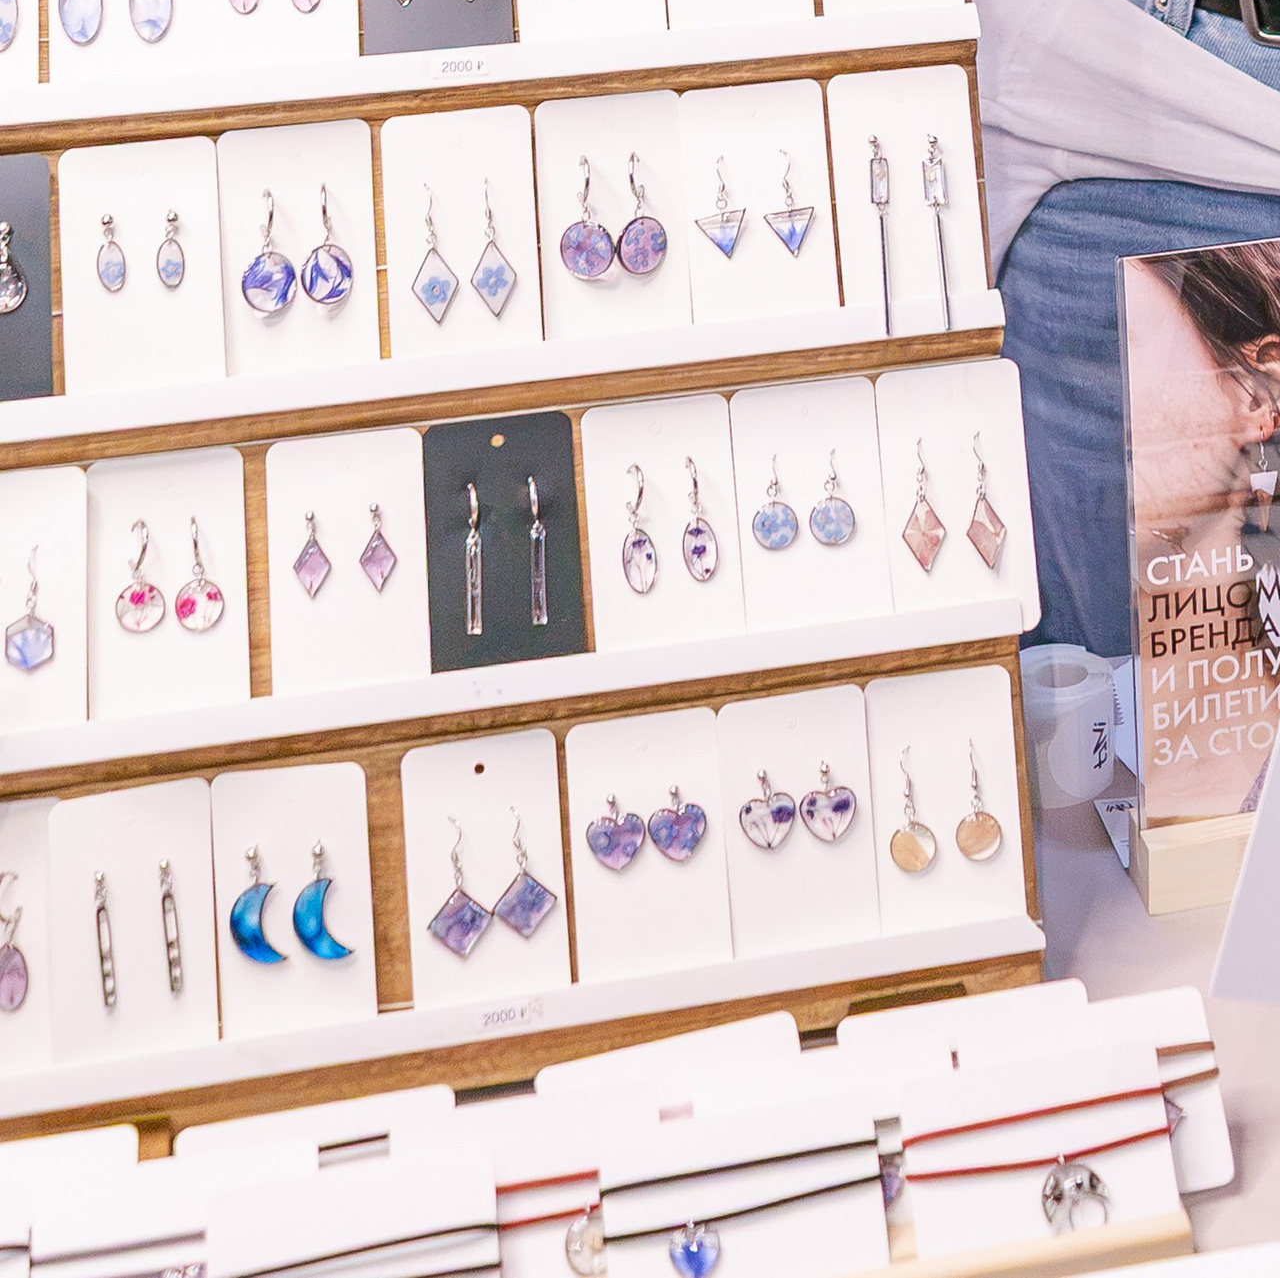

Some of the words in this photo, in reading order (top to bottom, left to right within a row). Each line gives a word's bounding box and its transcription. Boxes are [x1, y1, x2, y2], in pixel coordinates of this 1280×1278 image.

[441, 60, 473, 73] 2000
[1146, 545, 1254, 586] СТАНЬ
[1150, 613, 1280, 658] БРЕНДА
[1152, 664, 1176, 695] И
[1153, 734, 1199, 767] ЗА
[1208, 718, 1280, 756] СТО
[483, 1007, 516, 1027] 2000
